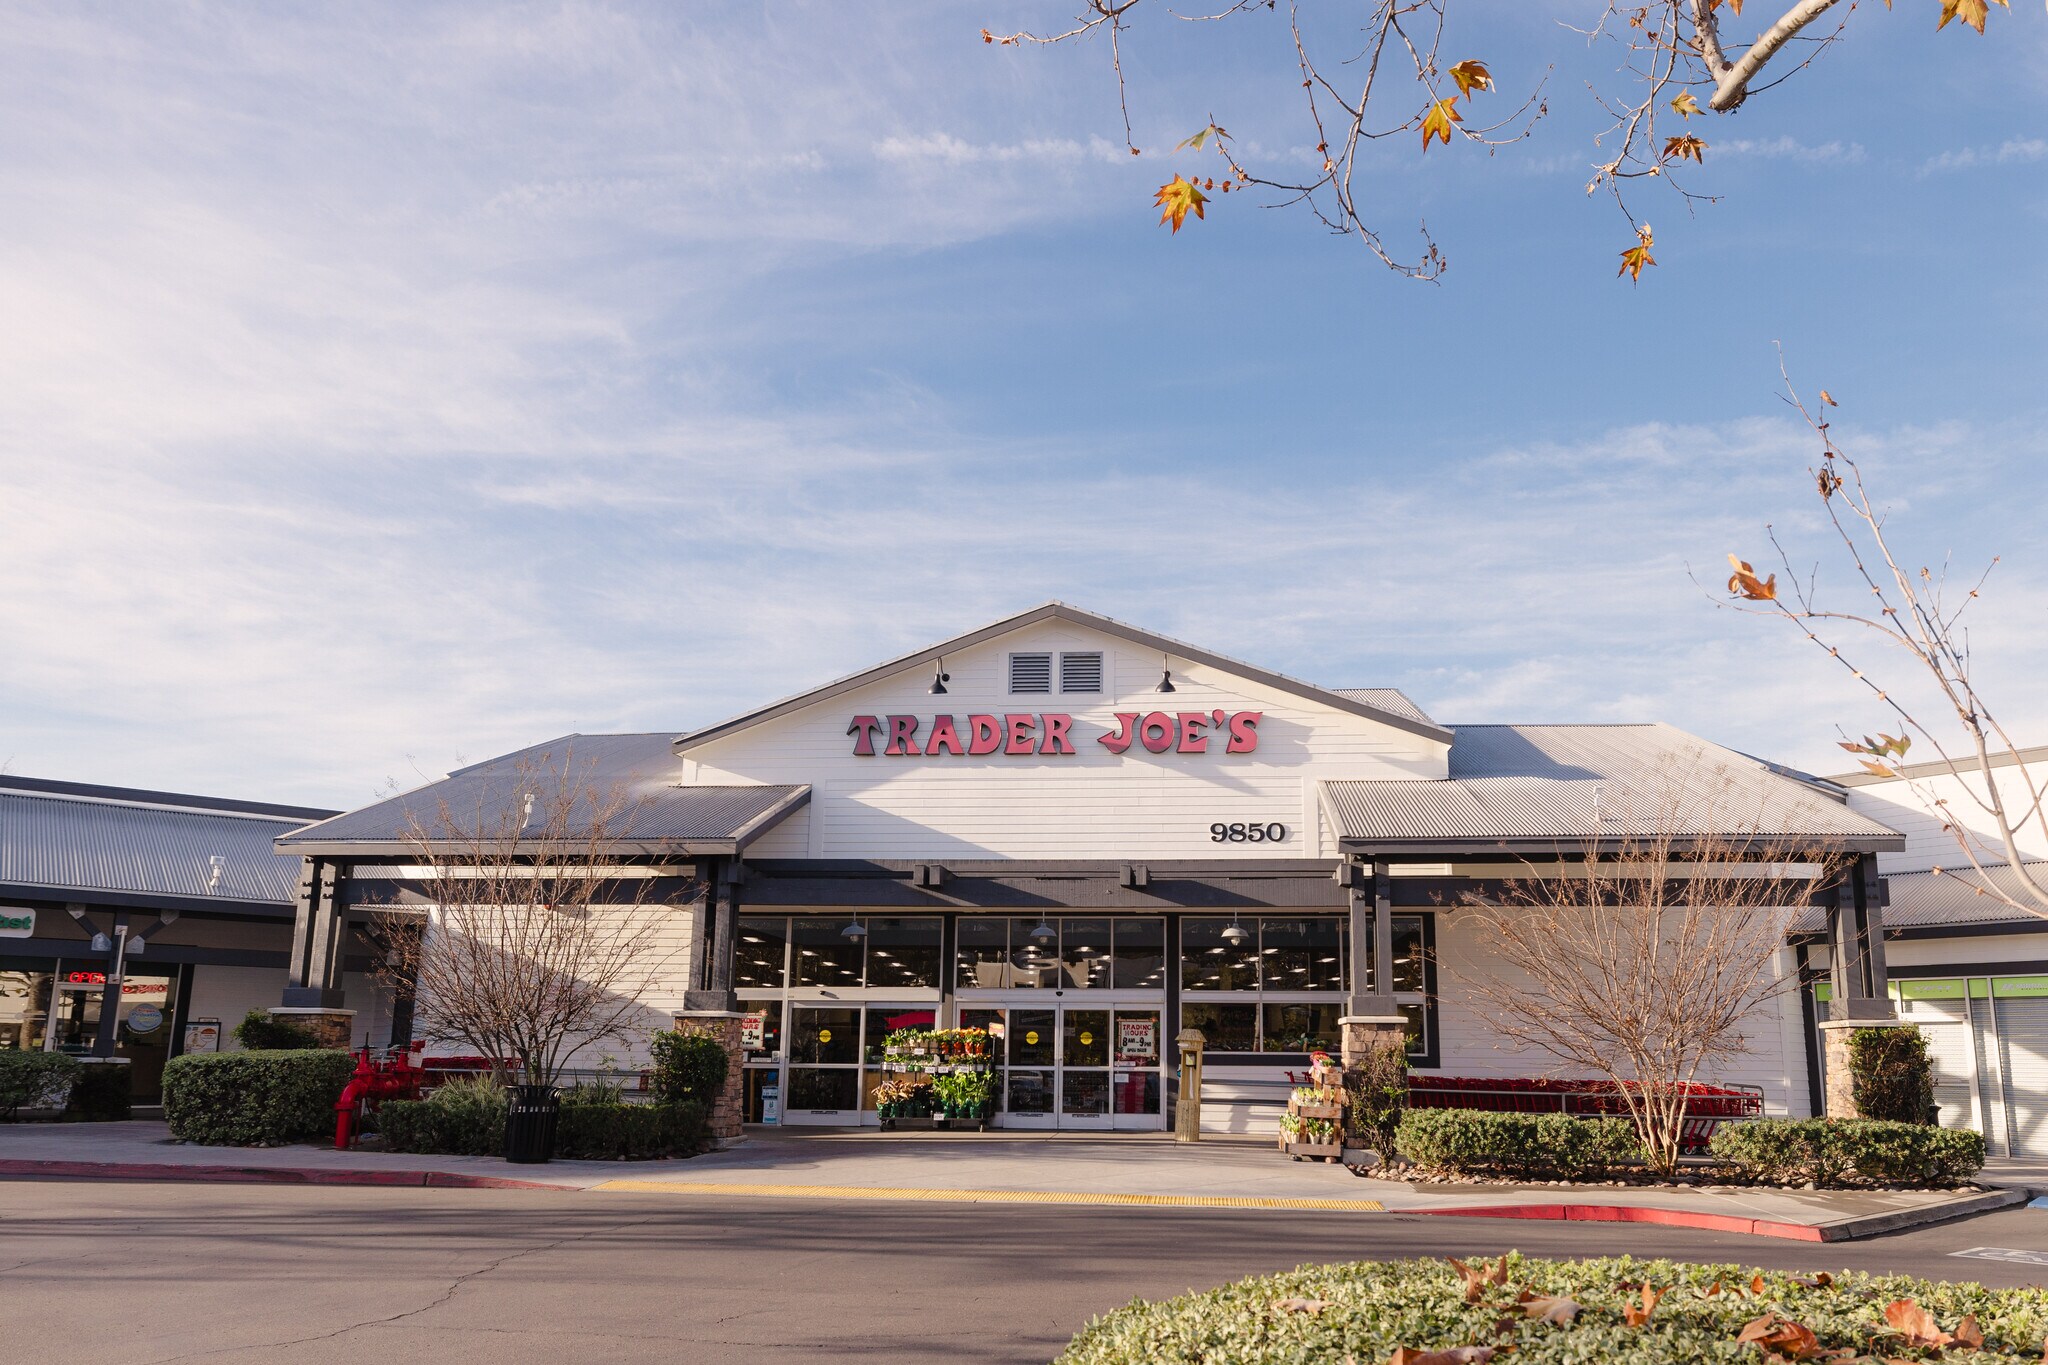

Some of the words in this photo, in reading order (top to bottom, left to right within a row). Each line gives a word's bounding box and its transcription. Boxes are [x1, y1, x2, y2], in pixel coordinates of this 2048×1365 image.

[846, 713, 1077, 756] TRADER
[1097, 708, 1263, 755] JOE'S
[1210, 822, 1286, 843] 9850
